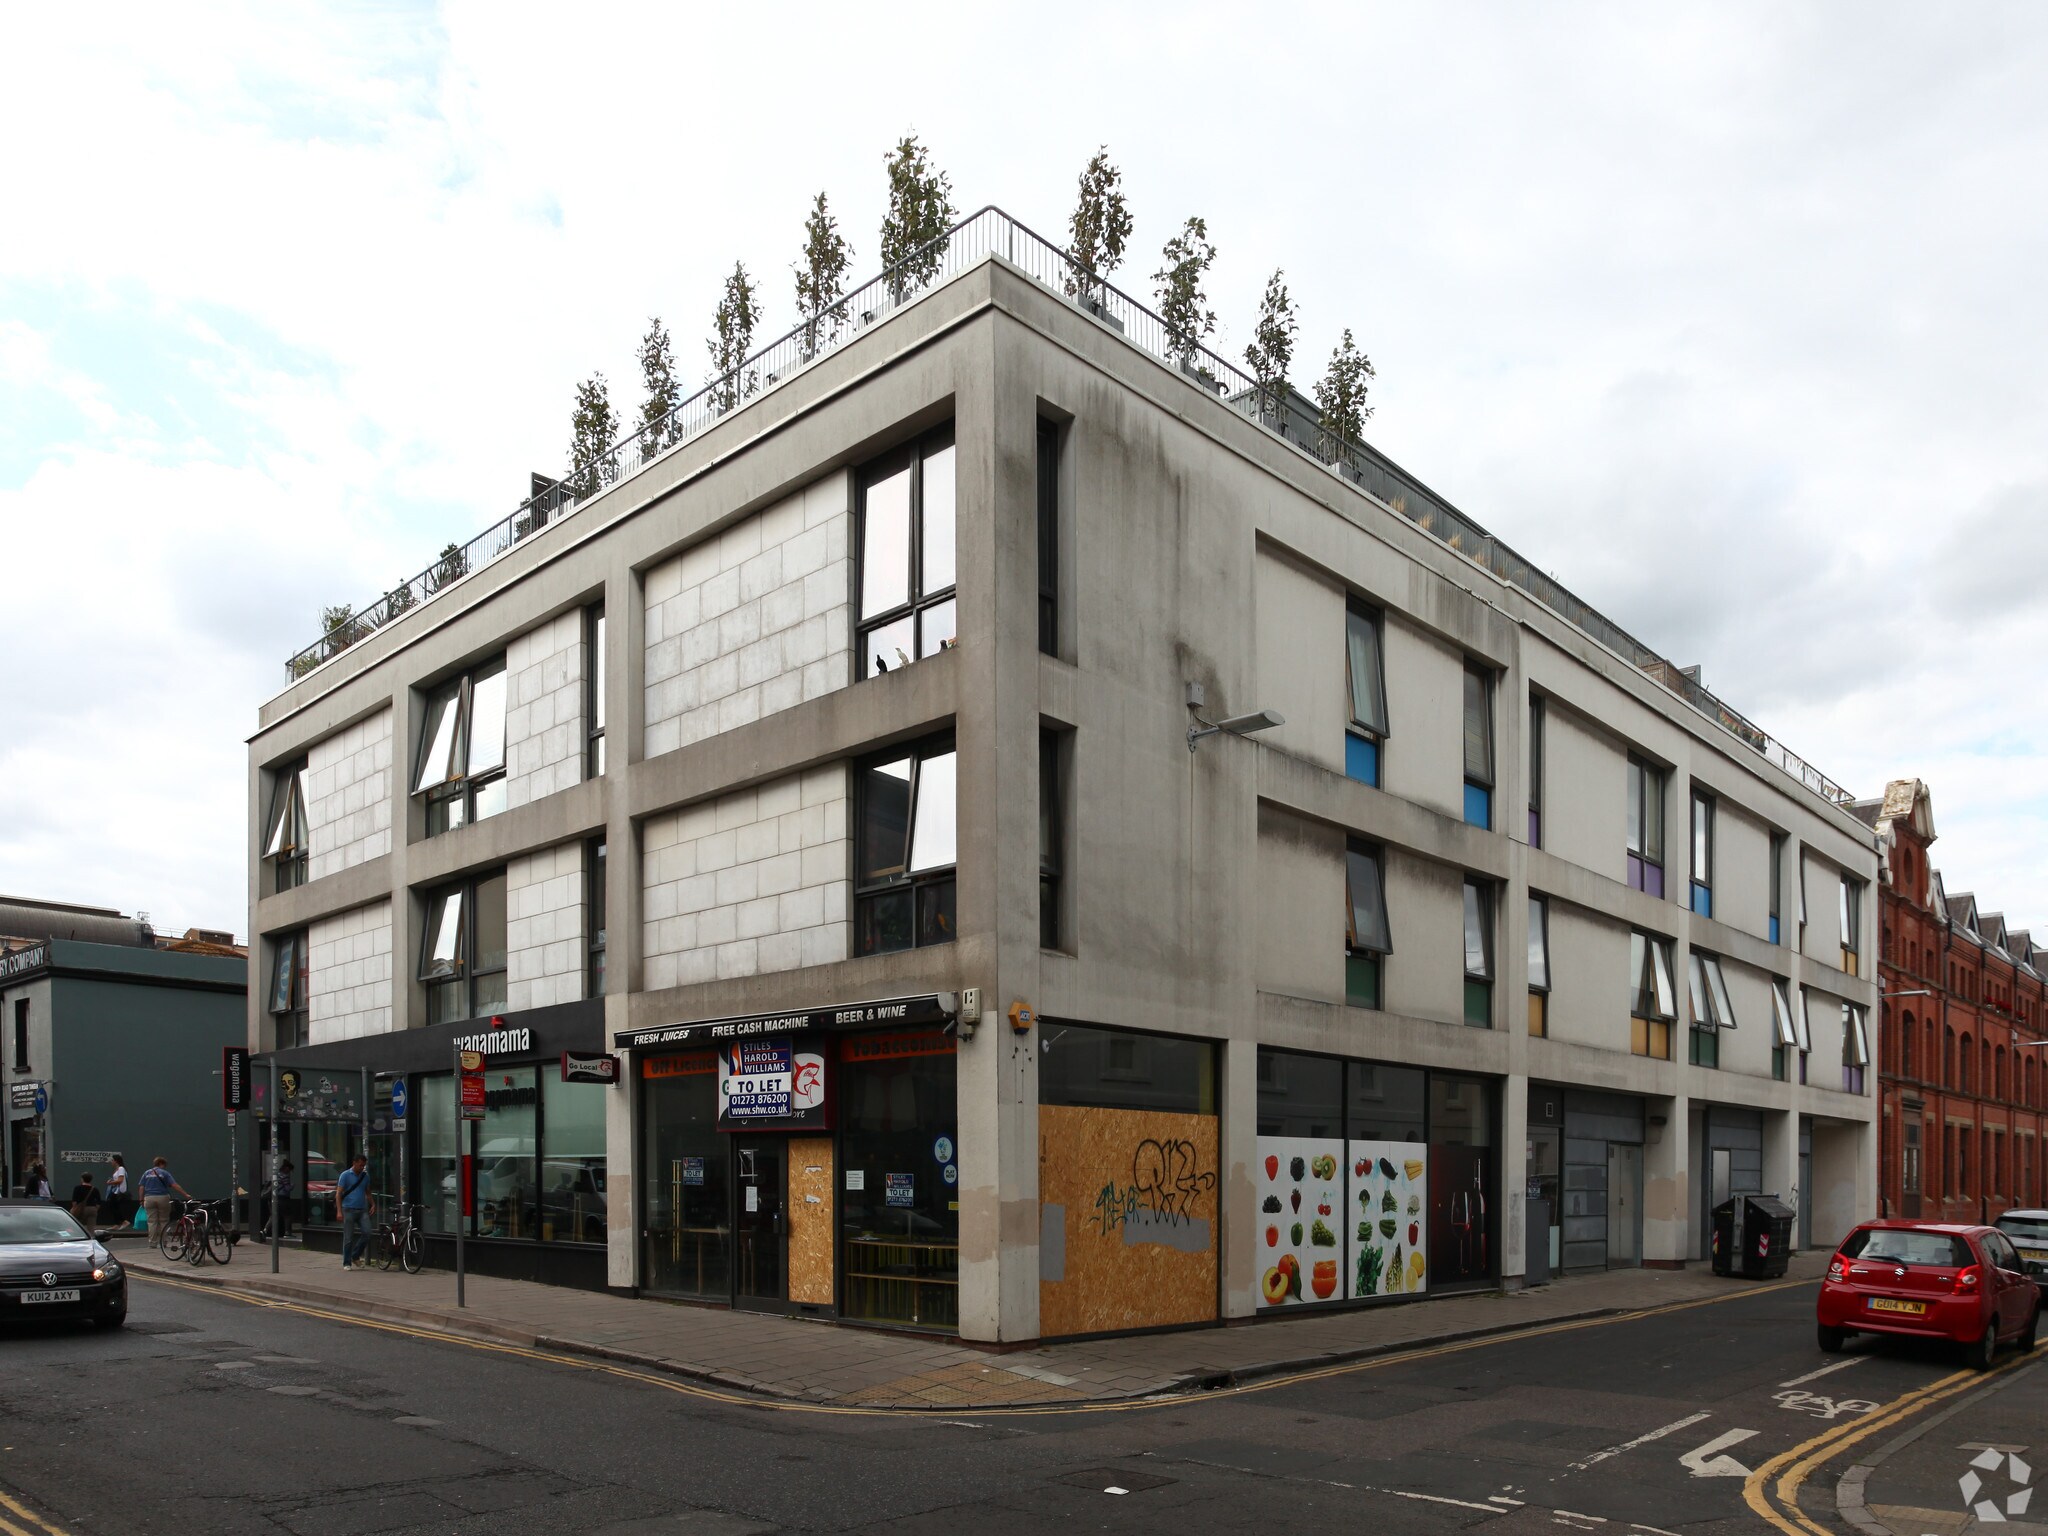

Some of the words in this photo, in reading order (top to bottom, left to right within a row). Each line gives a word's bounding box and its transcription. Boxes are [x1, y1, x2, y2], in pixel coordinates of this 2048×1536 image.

[9, 946, 44, 974] COMPANY
[836, 1009, 864, 1024] BEER
[866, 1008, 874, 1021] &
[877, 1004, 907, 1019] WINE
[711, 1025, 736, 1037] FREE
[737, 1021, 762, 1035] CASH
[764, 1016, 809, 1031] MACHINE
[634, 1032, 660, 1045] FRESH
[660, 1029, 690, 1042] JUICES
[744, 1042, 771, 1052] STILES
[744, 1052, 778, 1063] HAROLD
[568, 1062, 578, 1070] Go
[580, 1063, 598, 1071] Local
[744, 1062, 786, 1074] WILLIAMS
[229, 1053, 240, 1104] wagamama
[737, 1080, 754, 1093] TO
[760, 1079, 782, 1092] LET
[731, 1095, 756, 1105] 01273
[757, 1093, 788, 1104] 876200
[731, 1104, 788, 1115] www.shw.co.uk
[899, 1189, 909, 1197] LET
[27, 1292, 51, 1302] KU12
[53, 1291, 73, 1300] AXY
